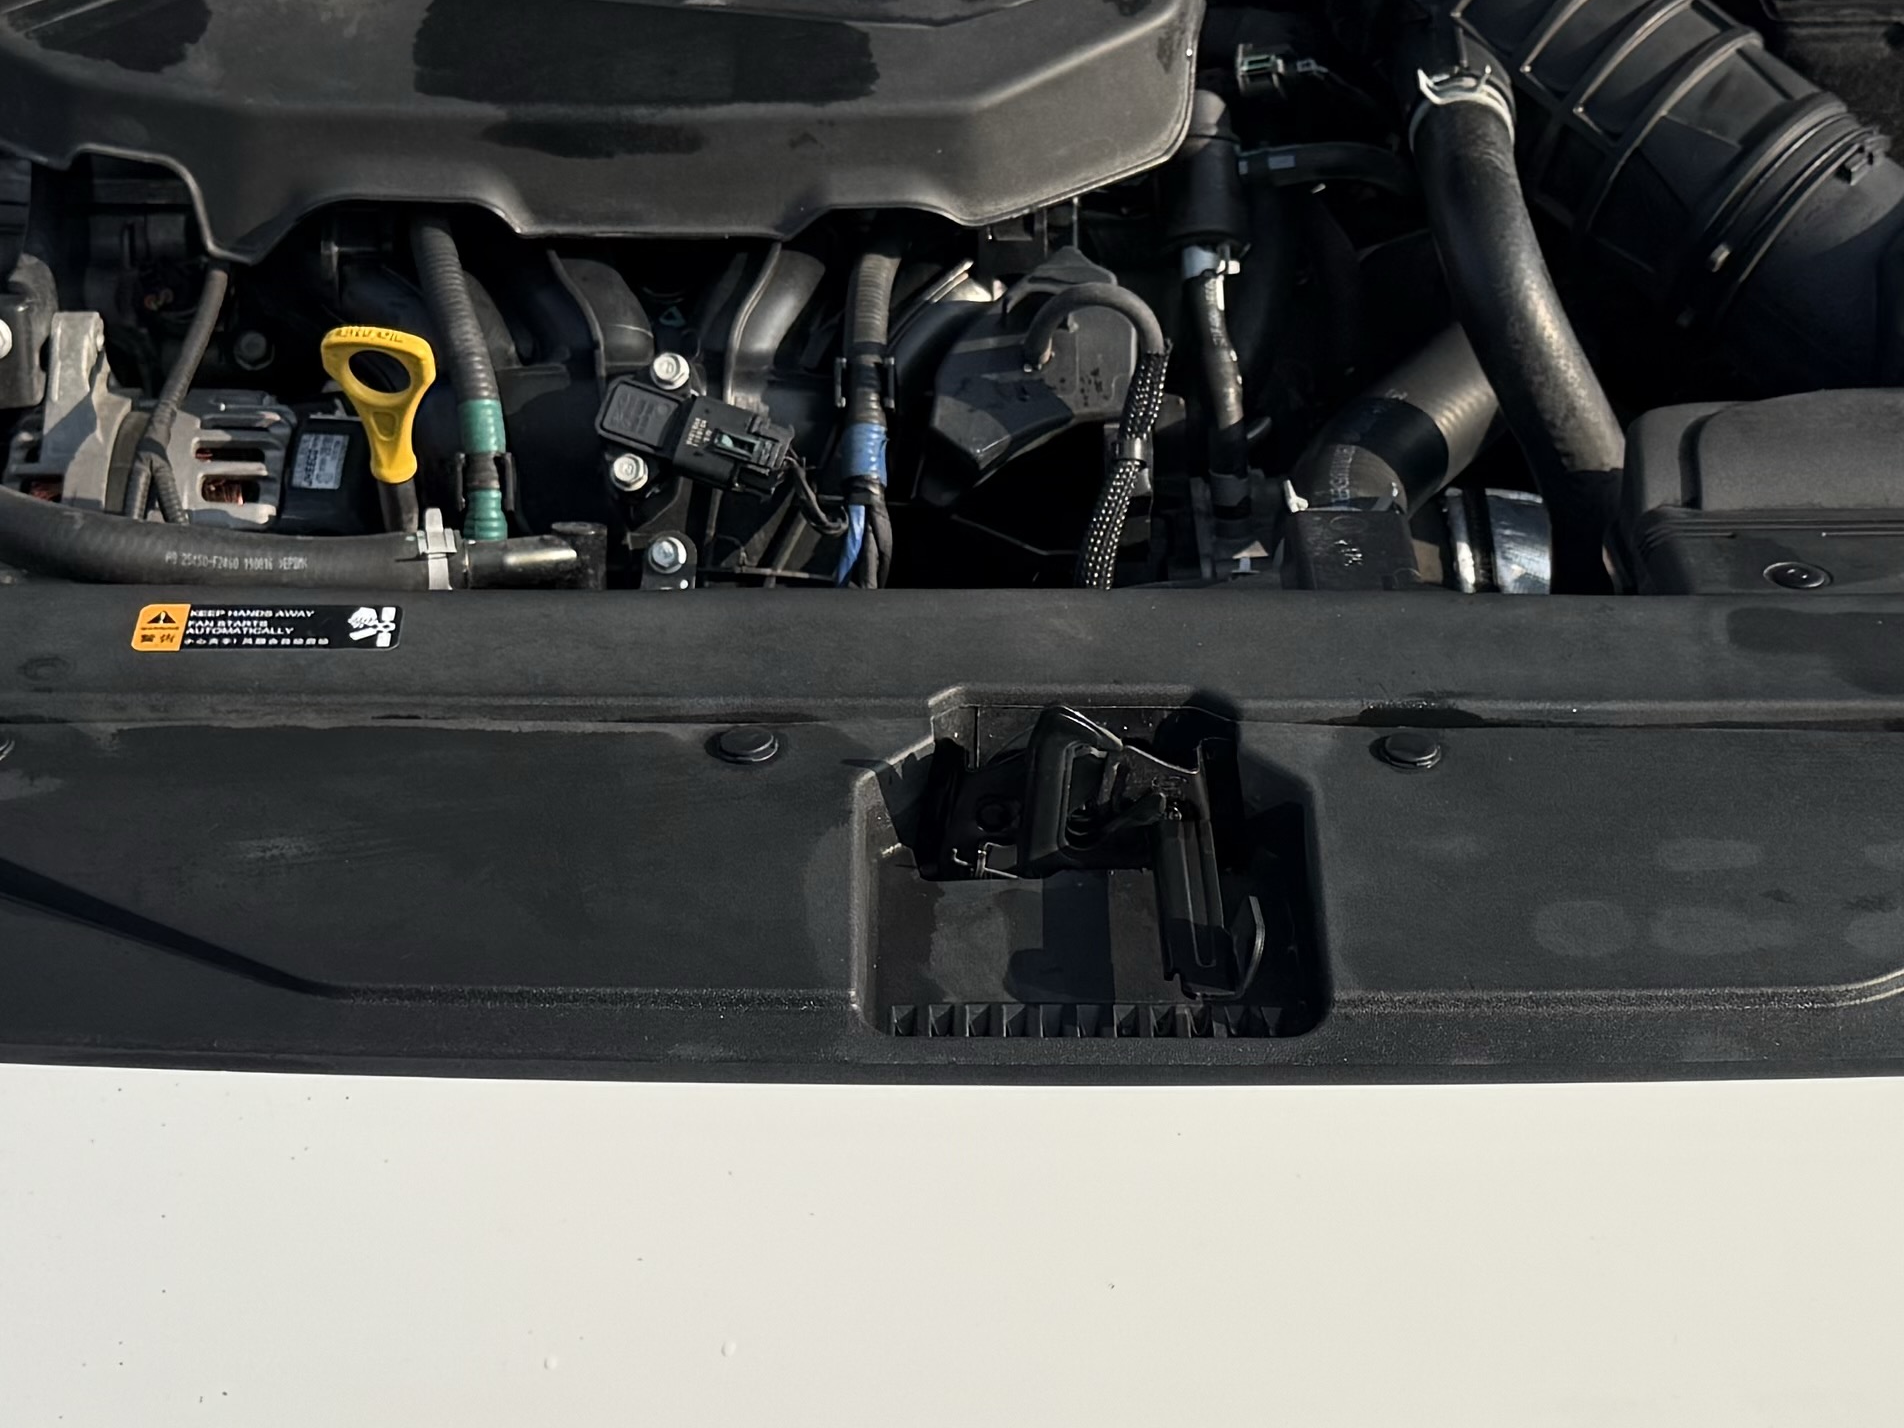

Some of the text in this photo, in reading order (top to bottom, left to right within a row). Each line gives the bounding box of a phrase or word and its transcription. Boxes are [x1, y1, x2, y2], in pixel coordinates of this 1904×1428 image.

[190, 609, 315, 618] KEEP HANDS AWAY
[187, 620, 214, 628] FAN
[217, 620, 268, 628] STARTS
[185, 627, 294, 635] AUTOMATICALLY
